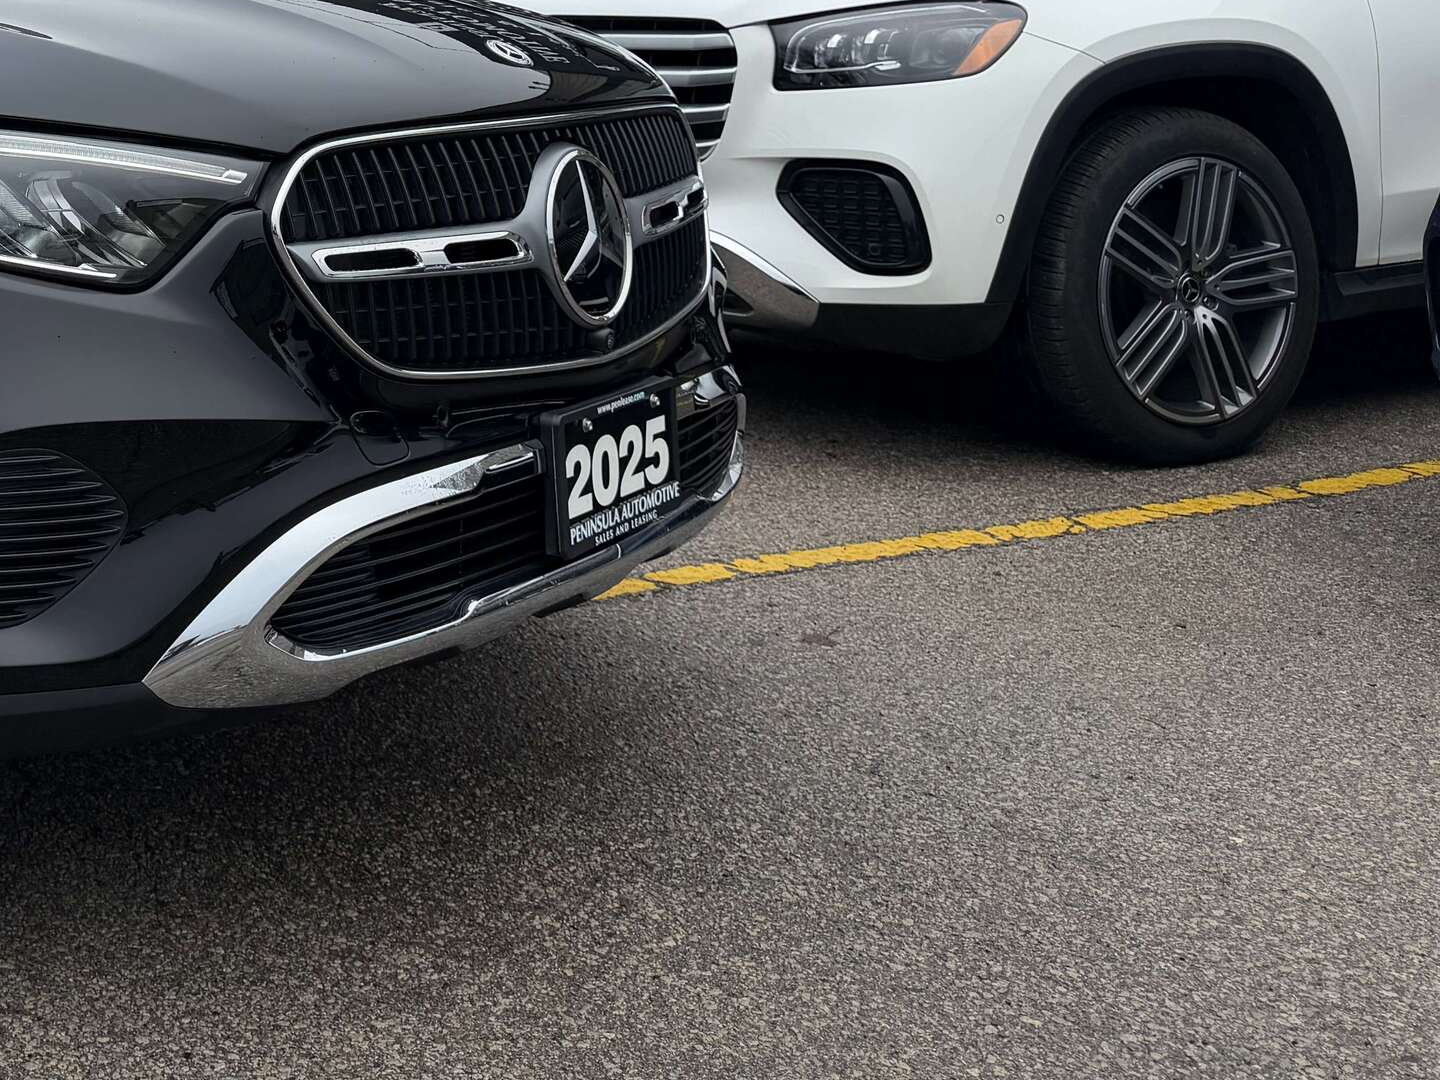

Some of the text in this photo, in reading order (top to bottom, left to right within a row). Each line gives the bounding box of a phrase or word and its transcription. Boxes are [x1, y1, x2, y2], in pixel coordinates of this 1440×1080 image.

[565, 414, 670, 520] 2025
[569, 481, 681, 546] PENINSULA AUTOMOTIVE
[594, 509, 658, 547] SALES AND LEASING
